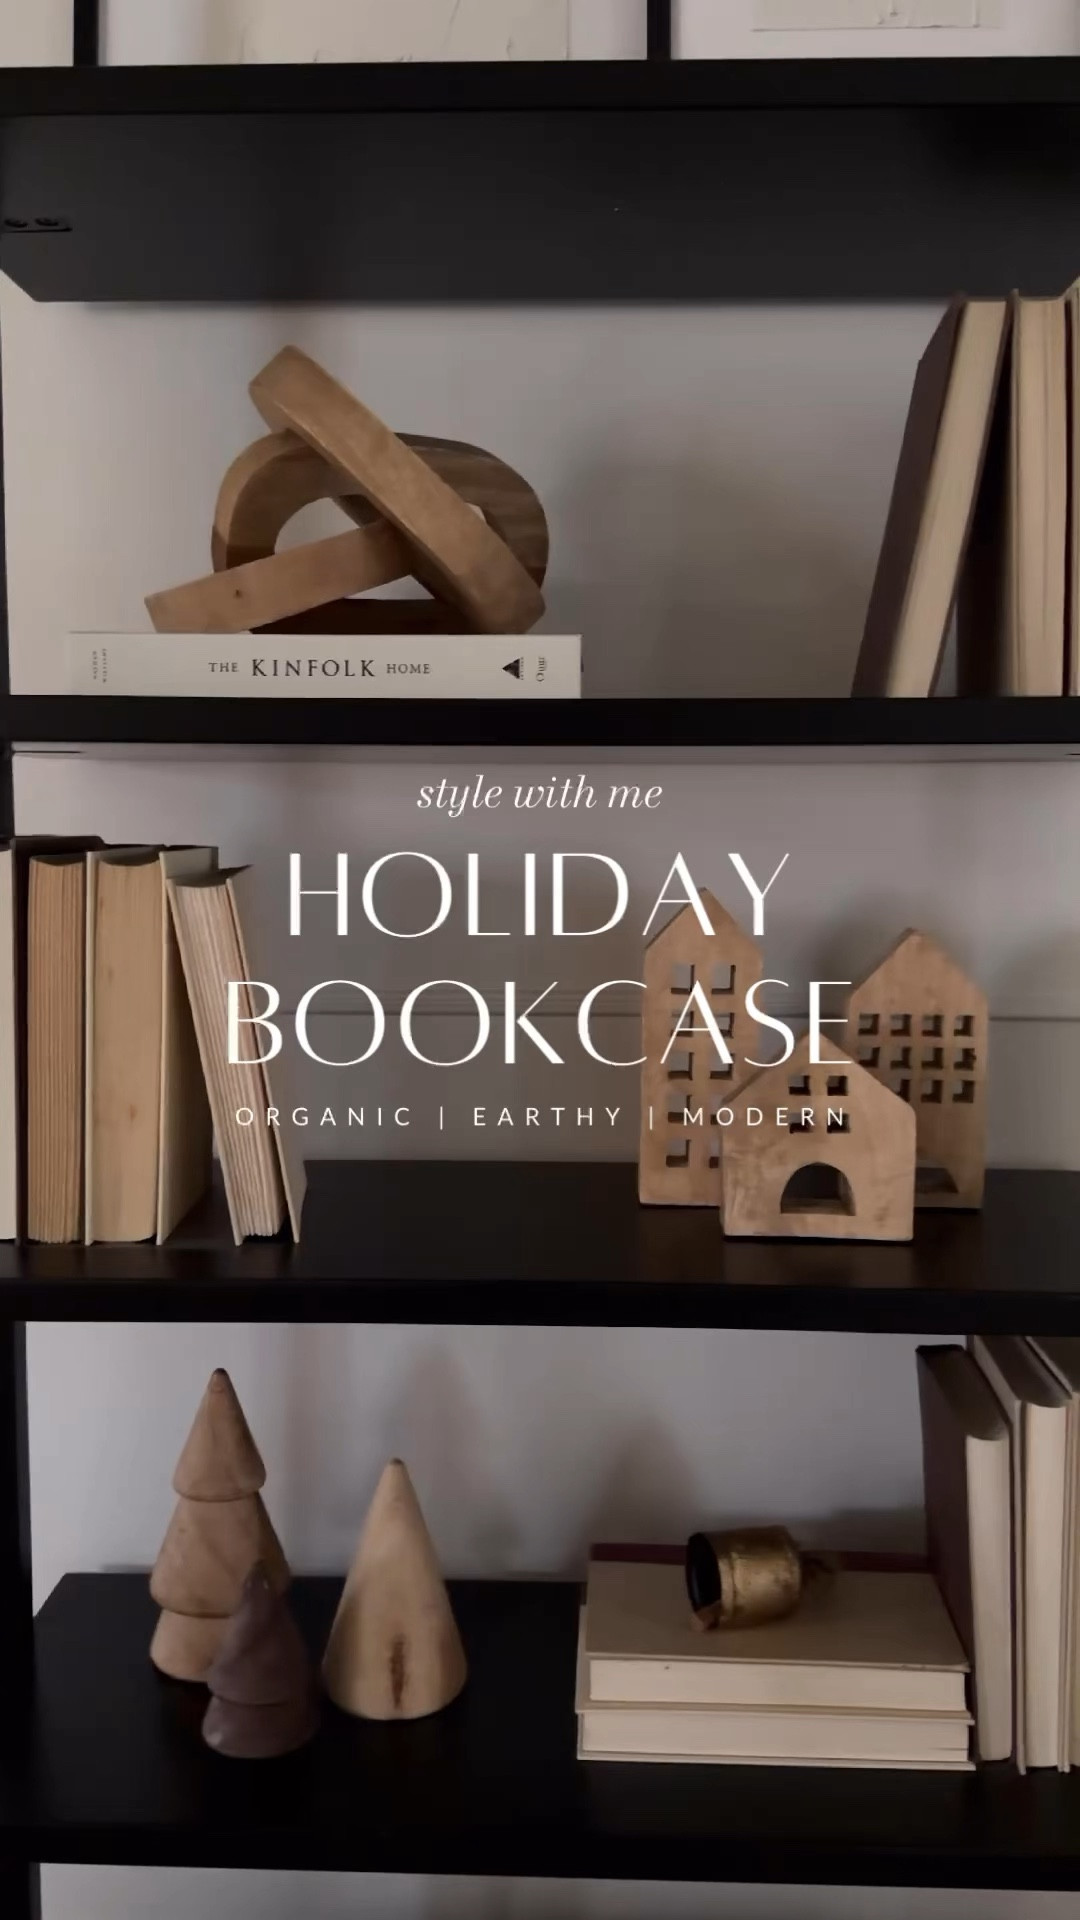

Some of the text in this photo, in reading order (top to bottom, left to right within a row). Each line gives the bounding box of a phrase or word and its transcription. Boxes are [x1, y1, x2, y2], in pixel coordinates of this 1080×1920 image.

[208, 658, 431, 678] THE KINFOLK HOME
